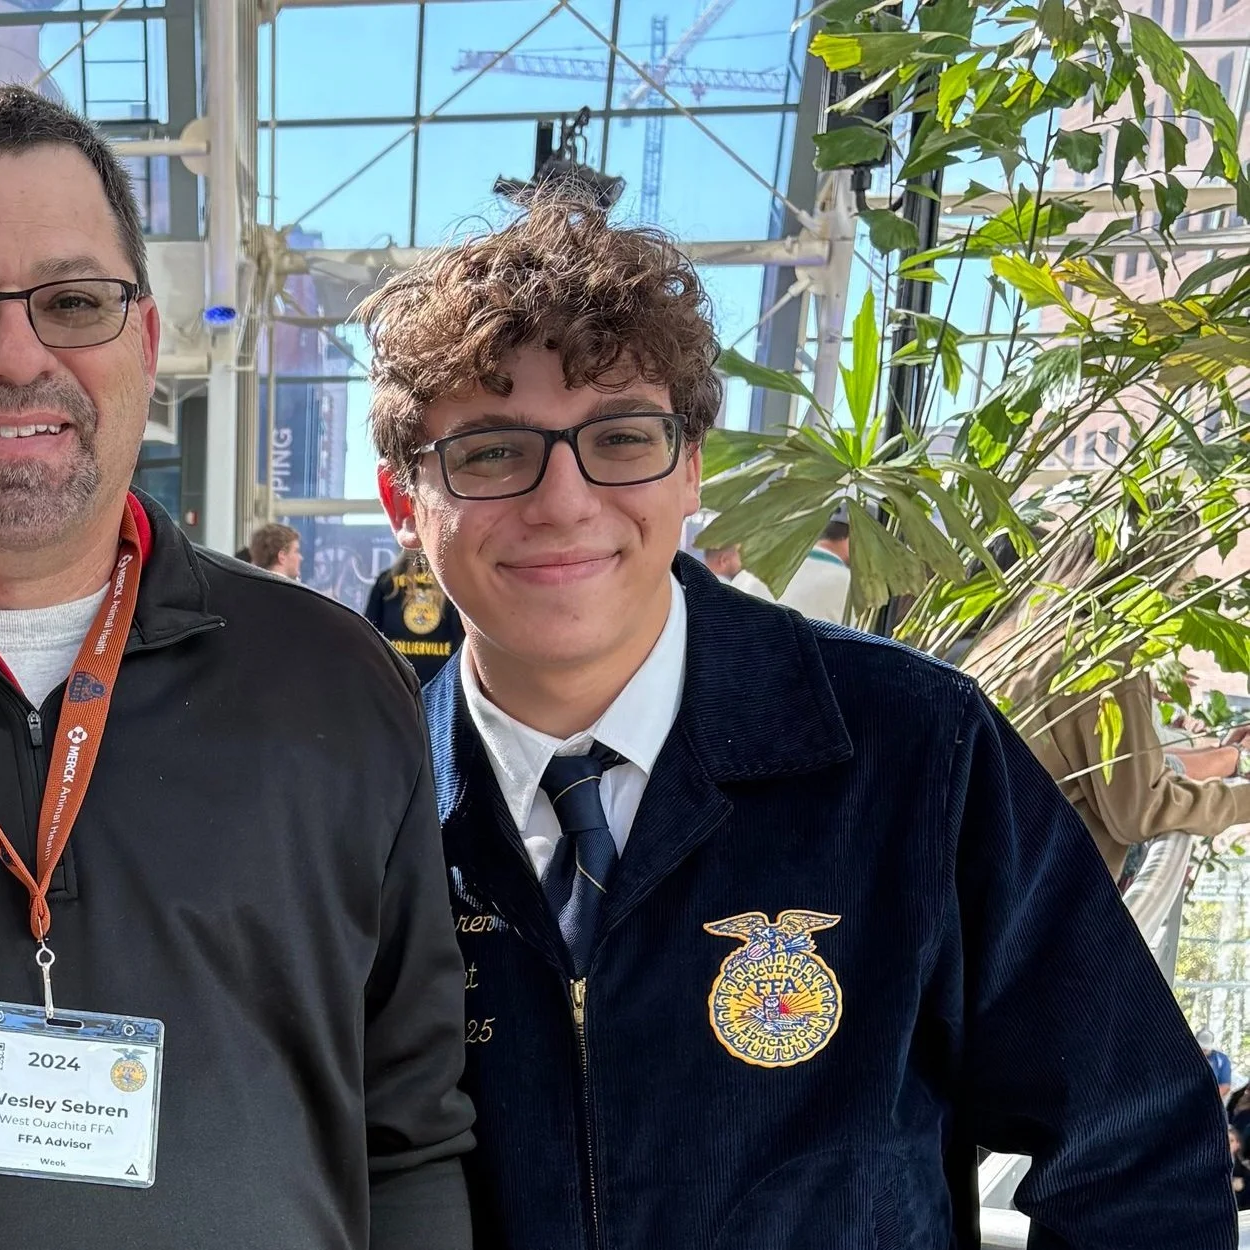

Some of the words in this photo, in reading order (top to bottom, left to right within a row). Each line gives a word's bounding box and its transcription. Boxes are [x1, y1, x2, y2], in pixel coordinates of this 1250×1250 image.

[272, 427, 293, 500] PING
[62, 745, 80, 783] MERCK
[53, 786, 72, 824] Animal
[732, 965, 818, 1002] AGRICULTURAL
[753, 979, 800, 997] FFA
[465, 1017, 496, 1043] 25
[27, 1051, 81, 1072] 2024
[61, 1099, 129, 1119] Sebren
[0, 1114, 30, 1127] West
[32, 1117, 87, 1133] Ouachita
[90, 1123, 114, 1136] FFA
[18, 1133, 42, 1145] FFA
[45, 1136, 92, 1151] Advisor
[40, 1157, 66, 1168] Week
